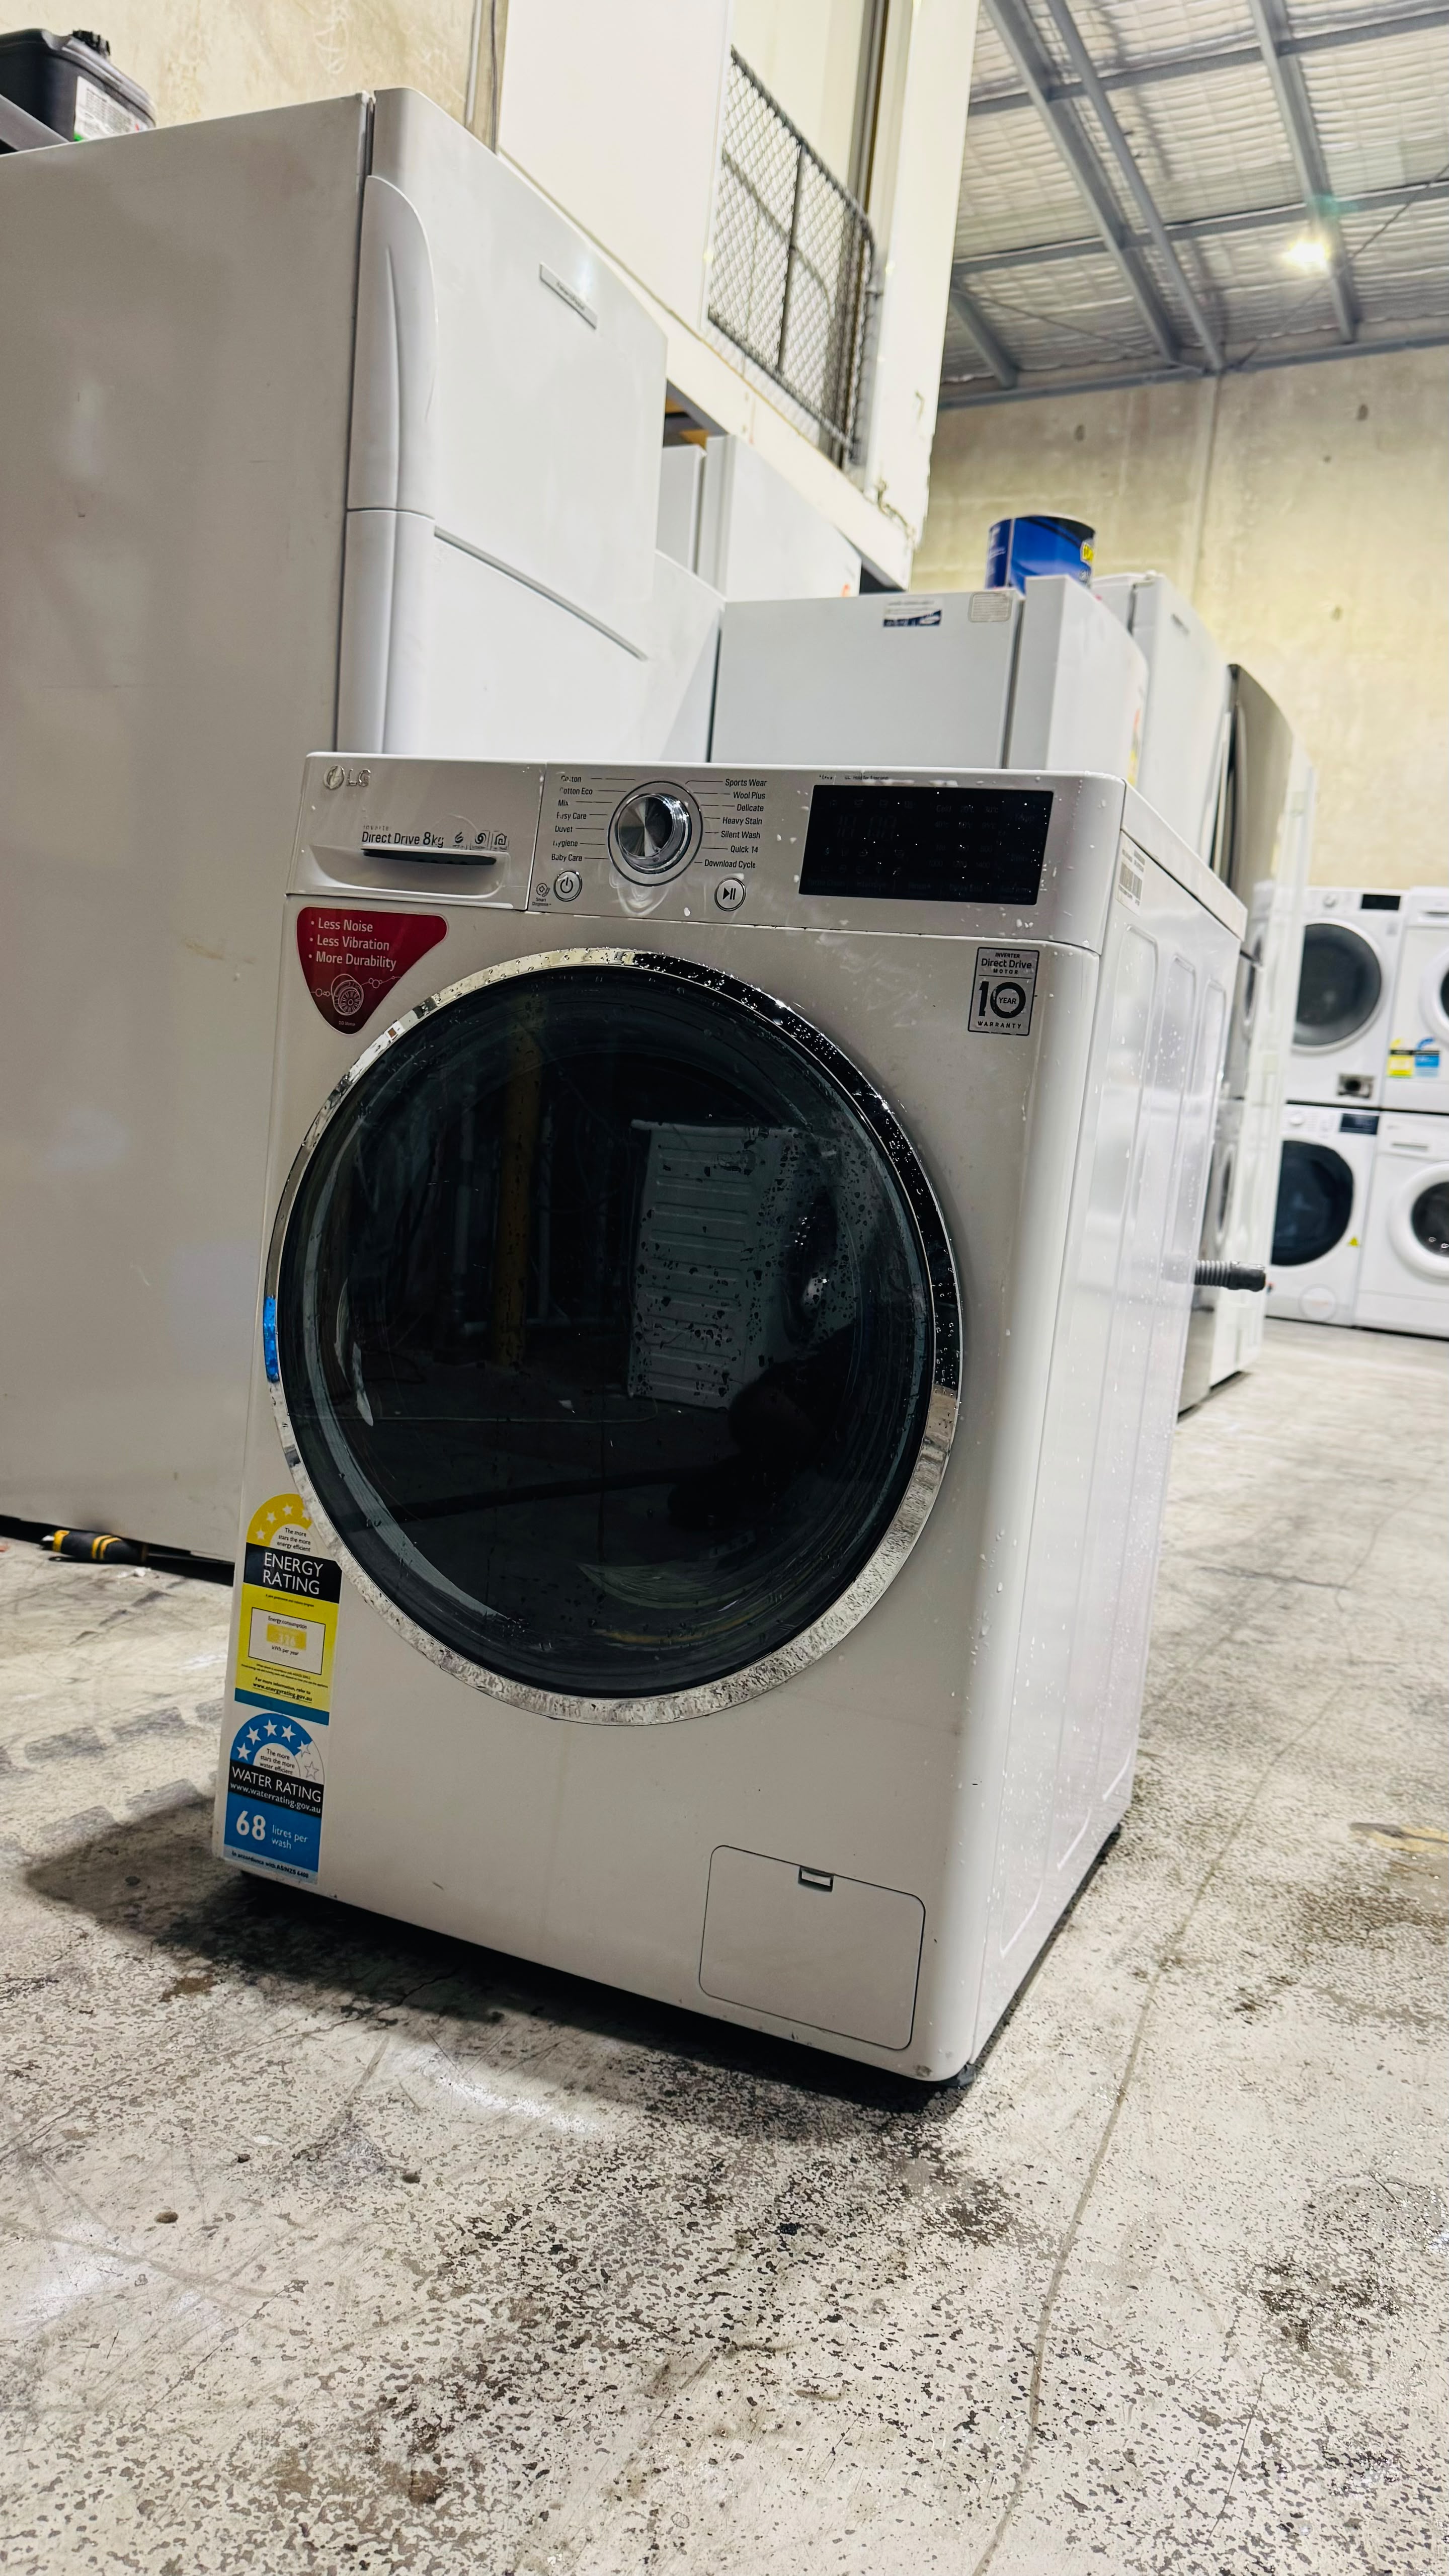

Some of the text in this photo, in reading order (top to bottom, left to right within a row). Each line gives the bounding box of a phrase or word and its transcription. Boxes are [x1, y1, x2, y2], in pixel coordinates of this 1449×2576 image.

[347, 768, 371, 786] LG
[725, 778, 747, 787] Sports
[733, 791, 750, 799] Wool
[737, 803, 764, 812] Delicate
[722, 817, 744, 826] Heavy
[362, 831, 391, 844] Direct
[394, 833, 420, 845] Drive
[721, 830, 740, 839] Silent
[551, 853, 567, 862] Baby
[704, 859, 756, 869] Download Cycle
[318, 917, 373, 932] Less Noise
[317, 934, 389, 950] Less Vibration
[316, 951, 396, 972] More Durability
[981, 958, 1032, 969] Direct Drive
[979, 981, 1026, 1019] 10
[978, 1021, 1021, 1029] WARRANTY
[264, 1552, 324, 1577] ENERGY
[263, 1569, 319, 1594] RATING
[268, 1616, 307, 1629] Energy consumption
[253, 1682, 312, 1701] www.energyrating.gov.au
[232, 1766, 321, 1802] WATER RATING
[230, 1782, 321, 1814] www.waterrating.gov.au
[236, 1810, 309, 1843] 68 litres per
[272, 1838, 291, 1849] wash
